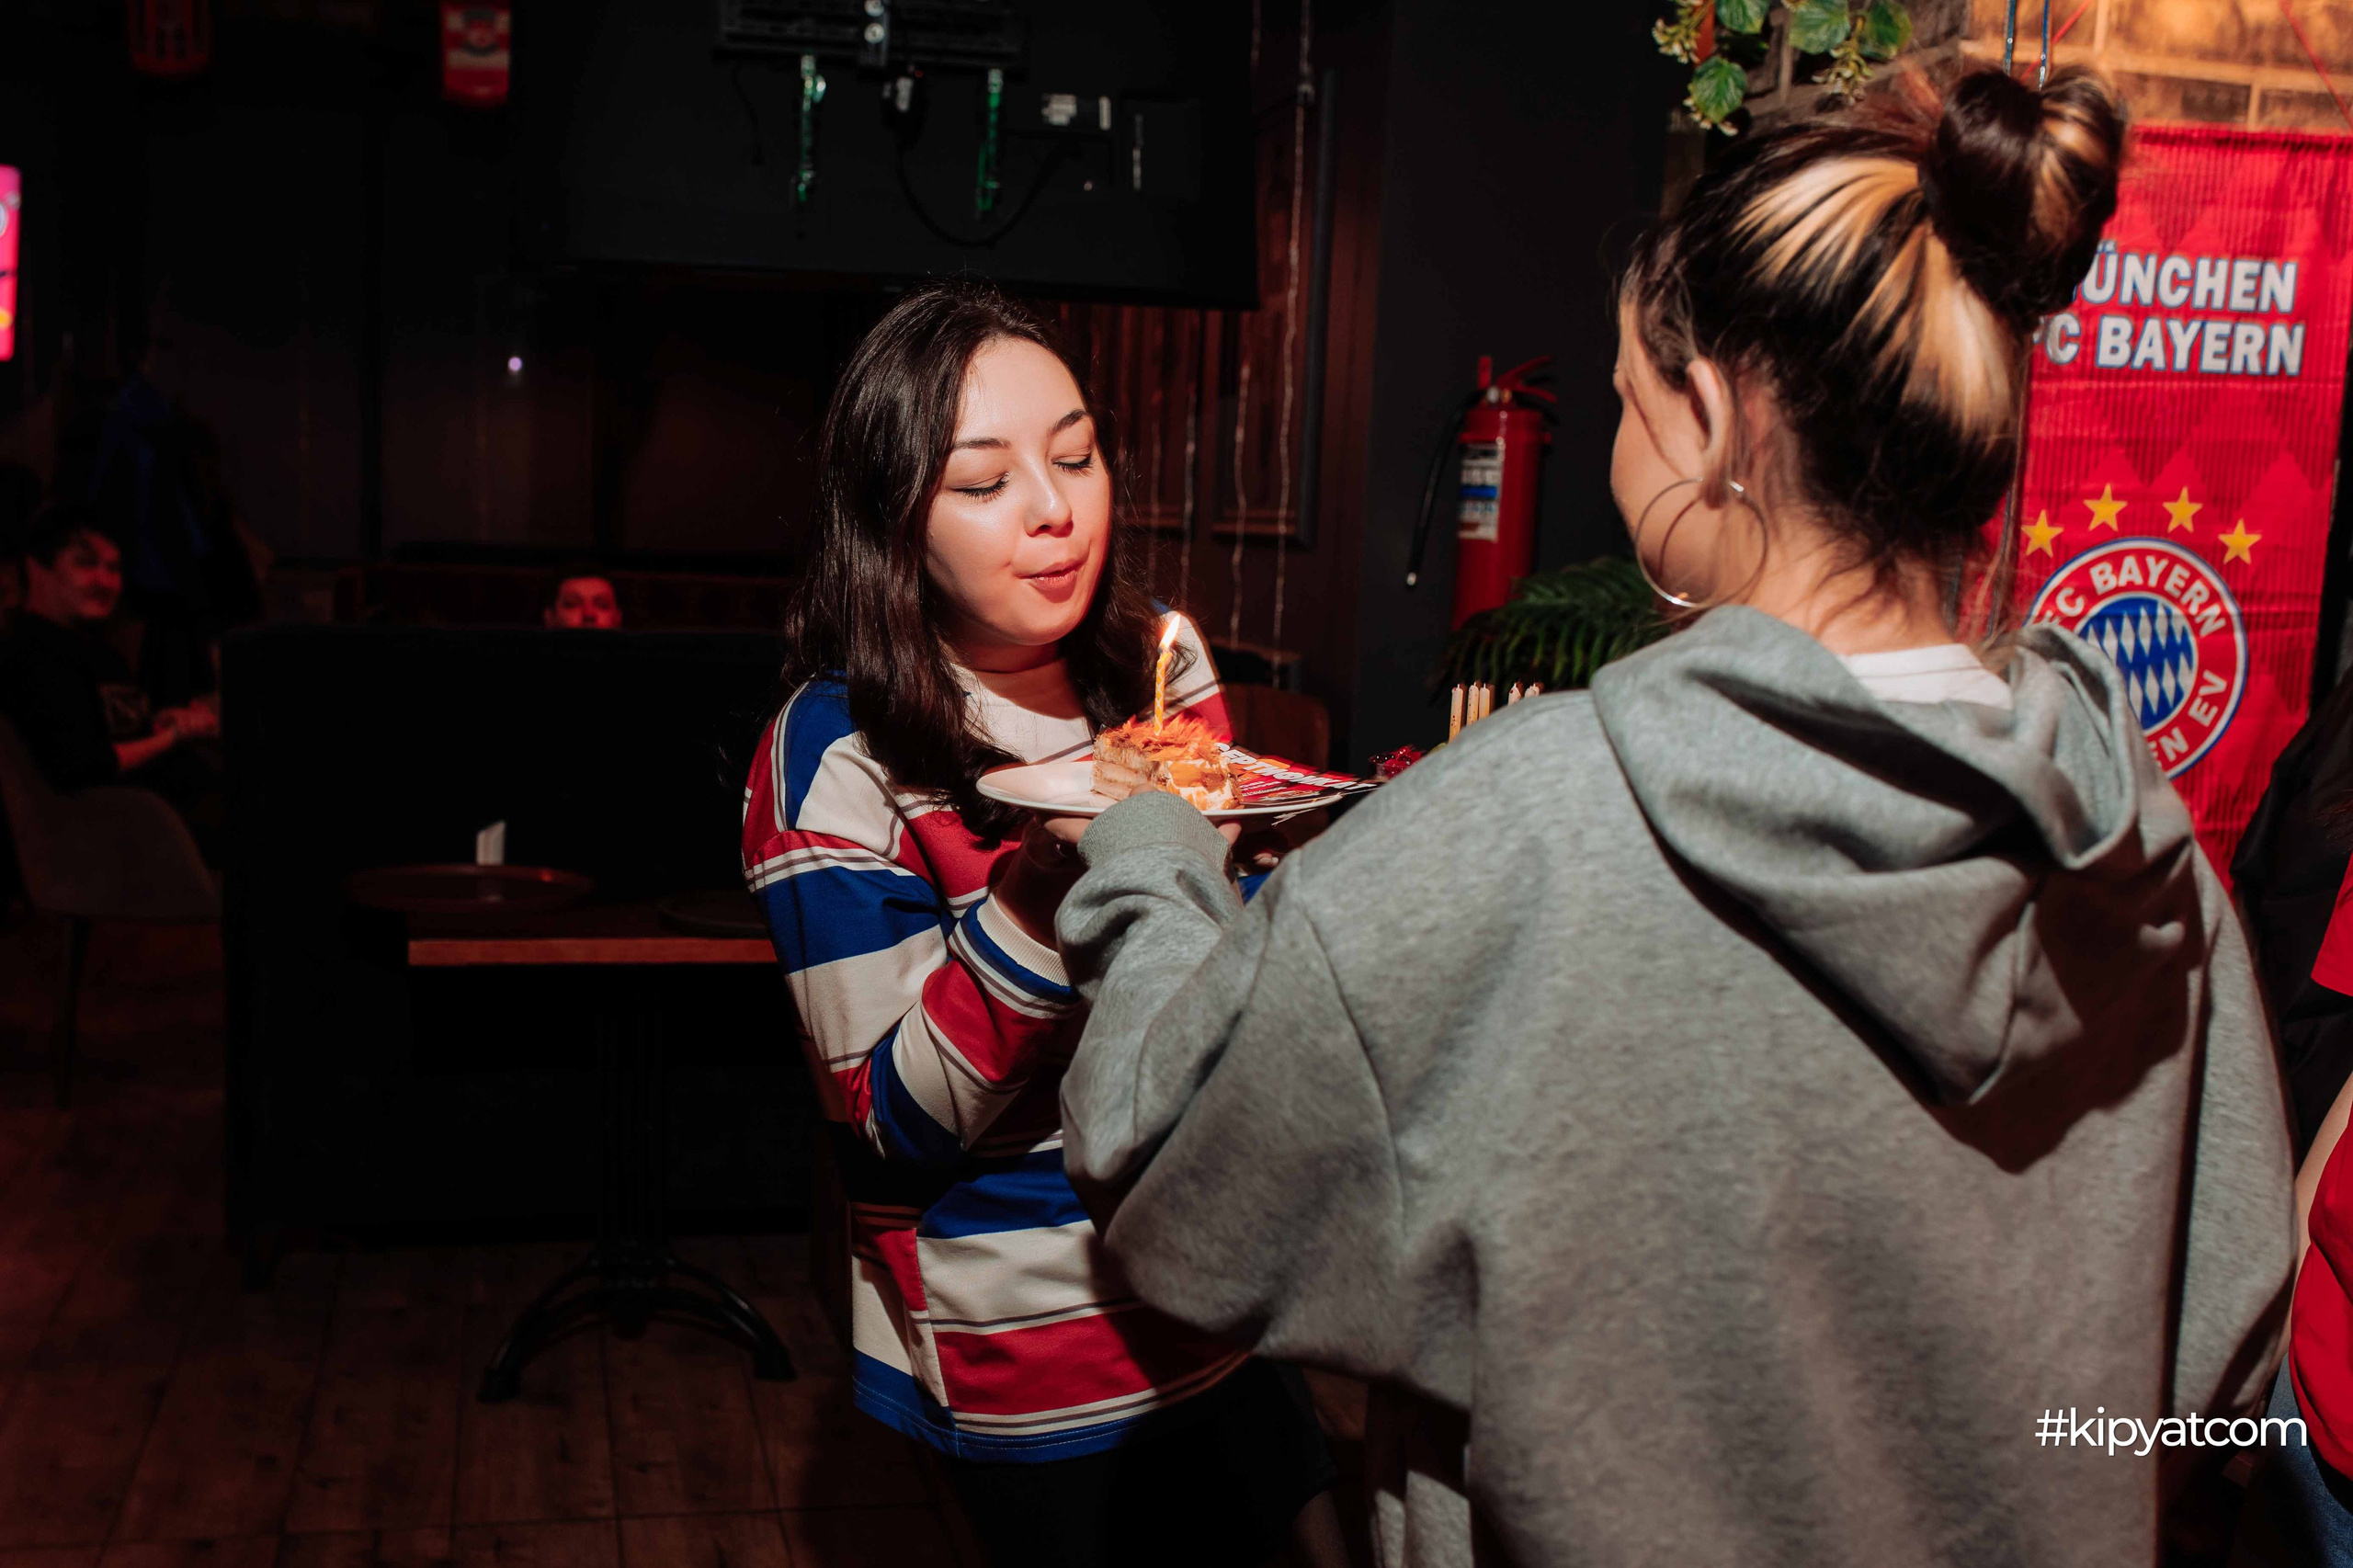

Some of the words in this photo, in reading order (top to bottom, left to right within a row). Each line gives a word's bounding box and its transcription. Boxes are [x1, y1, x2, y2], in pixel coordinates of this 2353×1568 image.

[2075, 241, 2298, 313] ÜNCHEN
[2032, 312, 2081, 365] C
[2096, 315, 2305, 376] BAYERN
[2089, 555, 2226, 637] BAYERN
[2188, 670, 2227, 727] EV
